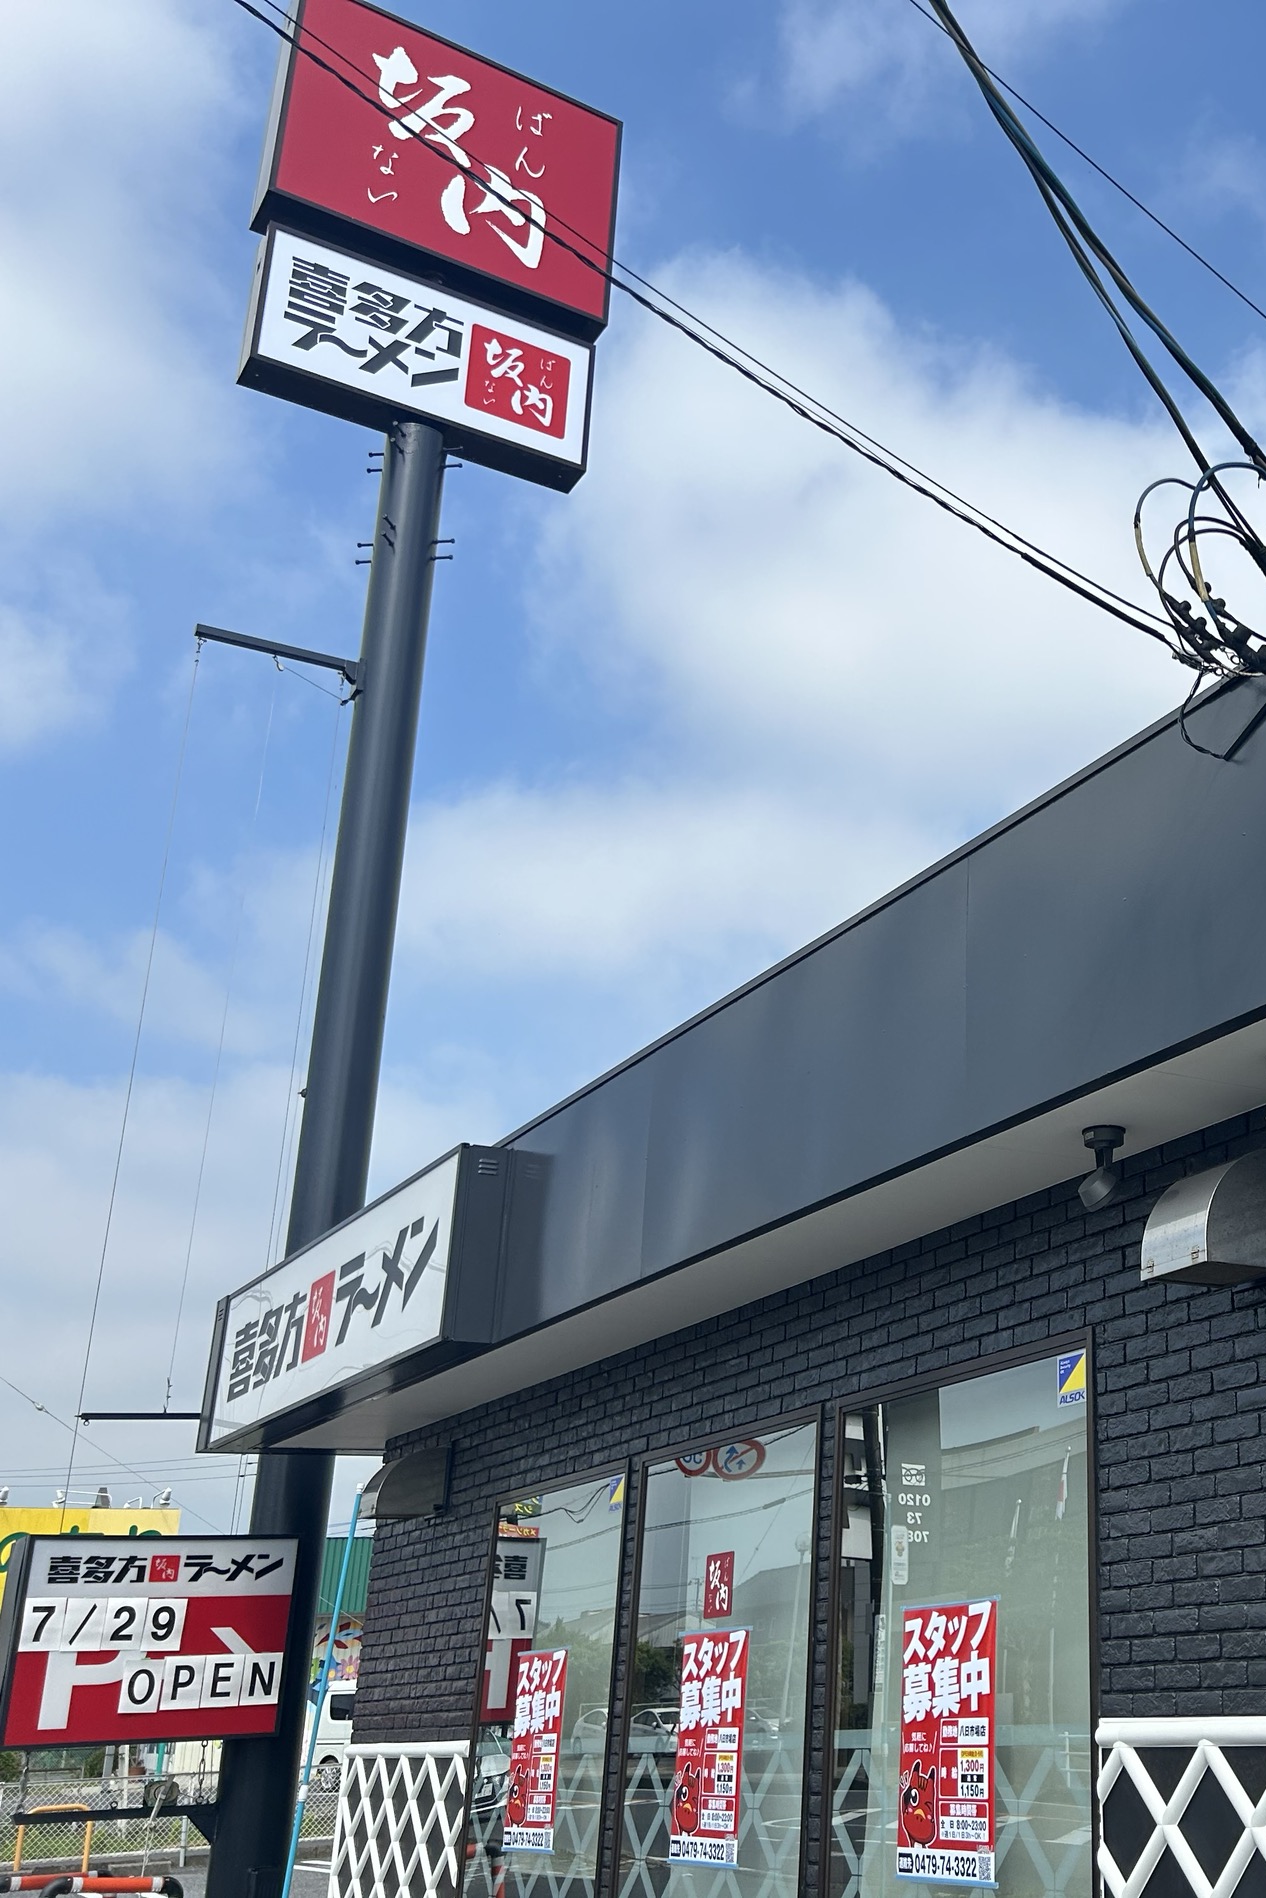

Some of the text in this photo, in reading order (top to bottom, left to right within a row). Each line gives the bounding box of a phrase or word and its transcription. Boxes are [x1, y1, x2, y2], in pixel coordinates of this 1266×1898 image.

[371, 46, 546, 269] 坂内
[514, 105, 552, 178] ばん
[367, 144, 399, 204] ない
[289, 256, 465, 358] 喜多方
[284, 300, 460, 387] ラーメン
[484, 338, 553, 427] 坂内
[227, 1291, 307, 1402] 喜多方
[335, 1215, 440, 1347] ラーメン
[1060, 1390, 1086, 1405] ALSOK
[47, 1555, 148, 1584] 喜多方
[184, 1554, 284, 1582] ラーメン
[709, 1560, 729, 1611] 坂内
[31, 1604, 176, 1646] 7/29
[903, 1600, 992, 1665] スタッフ
[517, 1650, 566, 1696] スタッフ
[682, 1630, 747, 1681] スタッフ
[128, 1661, 277, 1706] OPEN
[680, 1671, 742, 1732] 募集中
[903, 1650, 991, 1724] 募集中
[514, 1685, 561, 1739] 募集中
[960, 1759, 985, 1773] 1,300円
[960, 1784, 985, 1798] 1,150円
[682, 1841, 725, 1861] 0479-74-3322
[915, 1854, 977, 1878] 0479-74-3322
